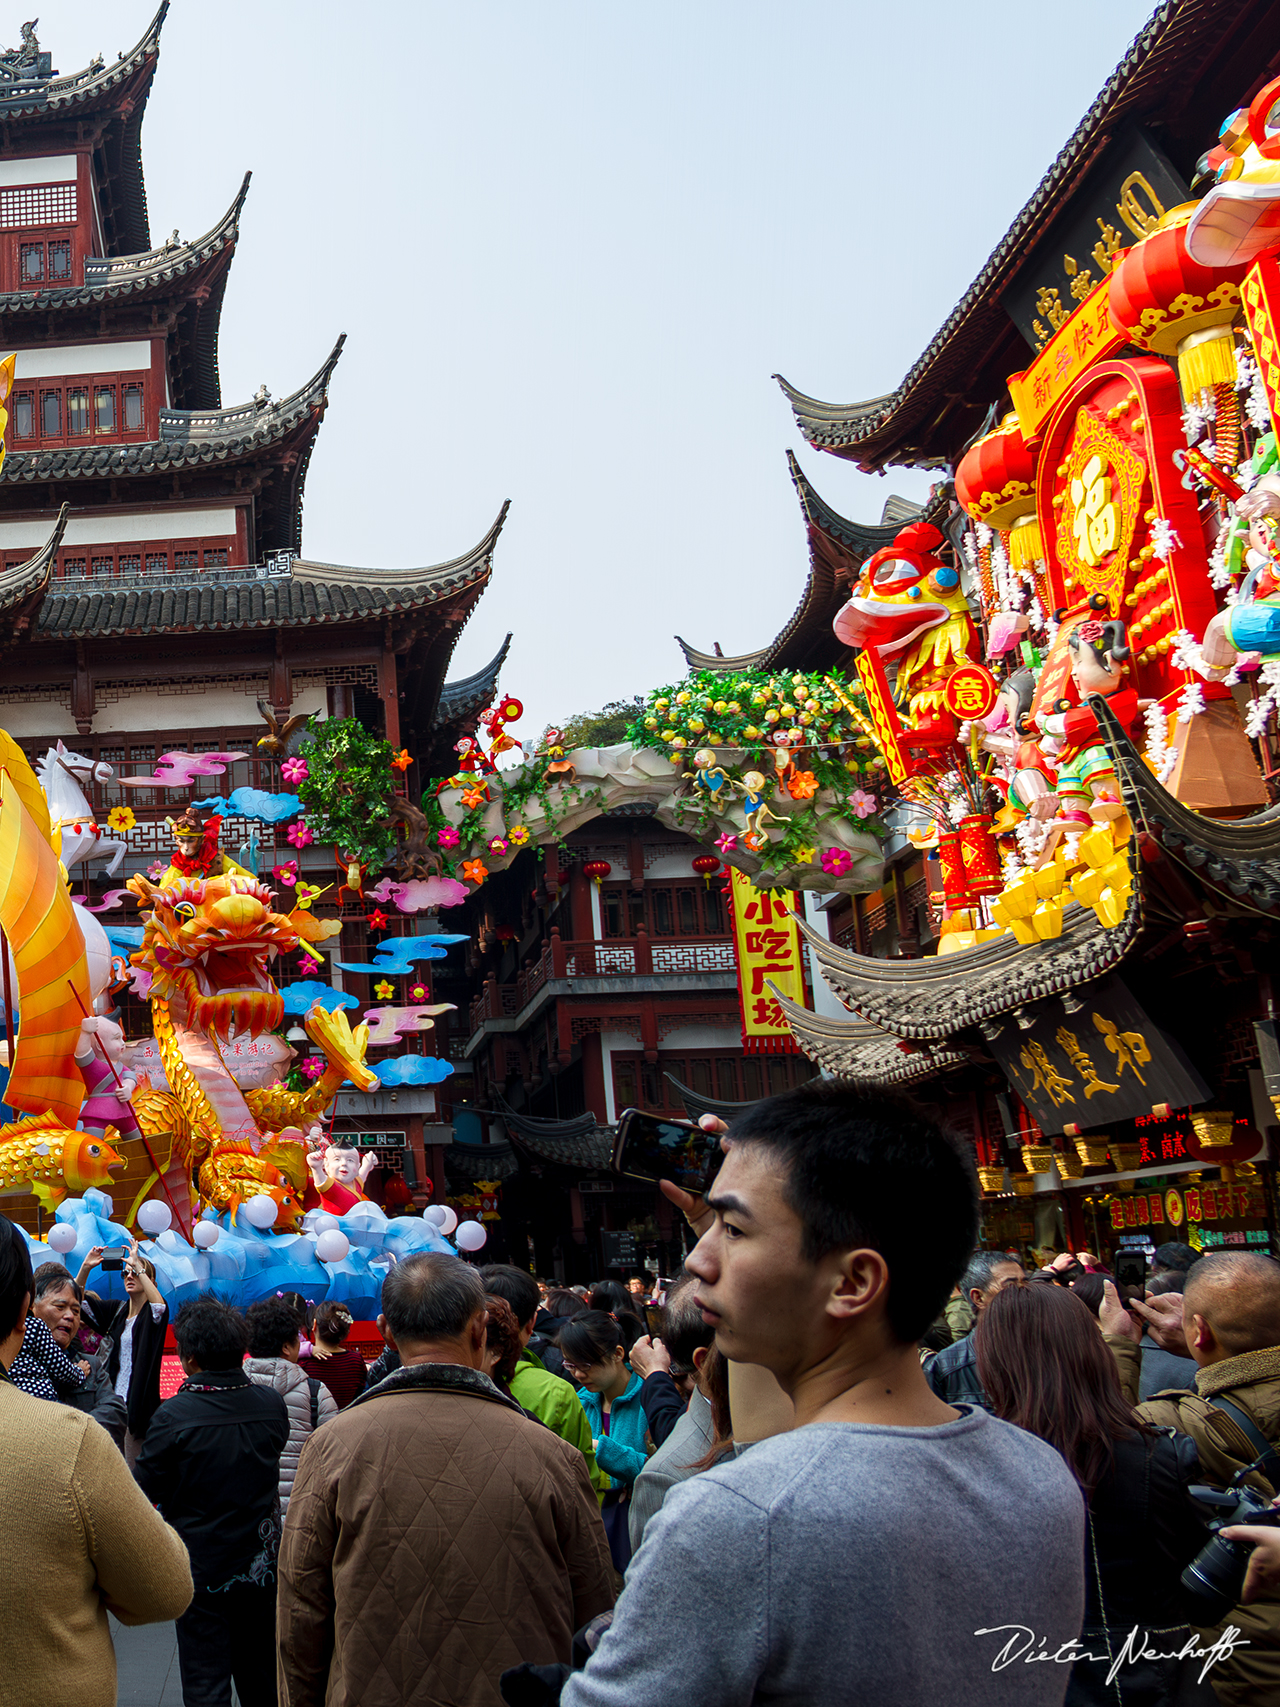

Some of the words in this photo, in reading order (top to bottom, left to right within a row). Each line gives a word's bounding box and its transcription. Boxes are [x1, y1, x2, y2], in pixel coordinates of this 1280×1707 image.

[1070, 454, 1122, 567] 福
[953, 676, 984, 711] 意
[744, 893, 794, 1028] 小吃广场
